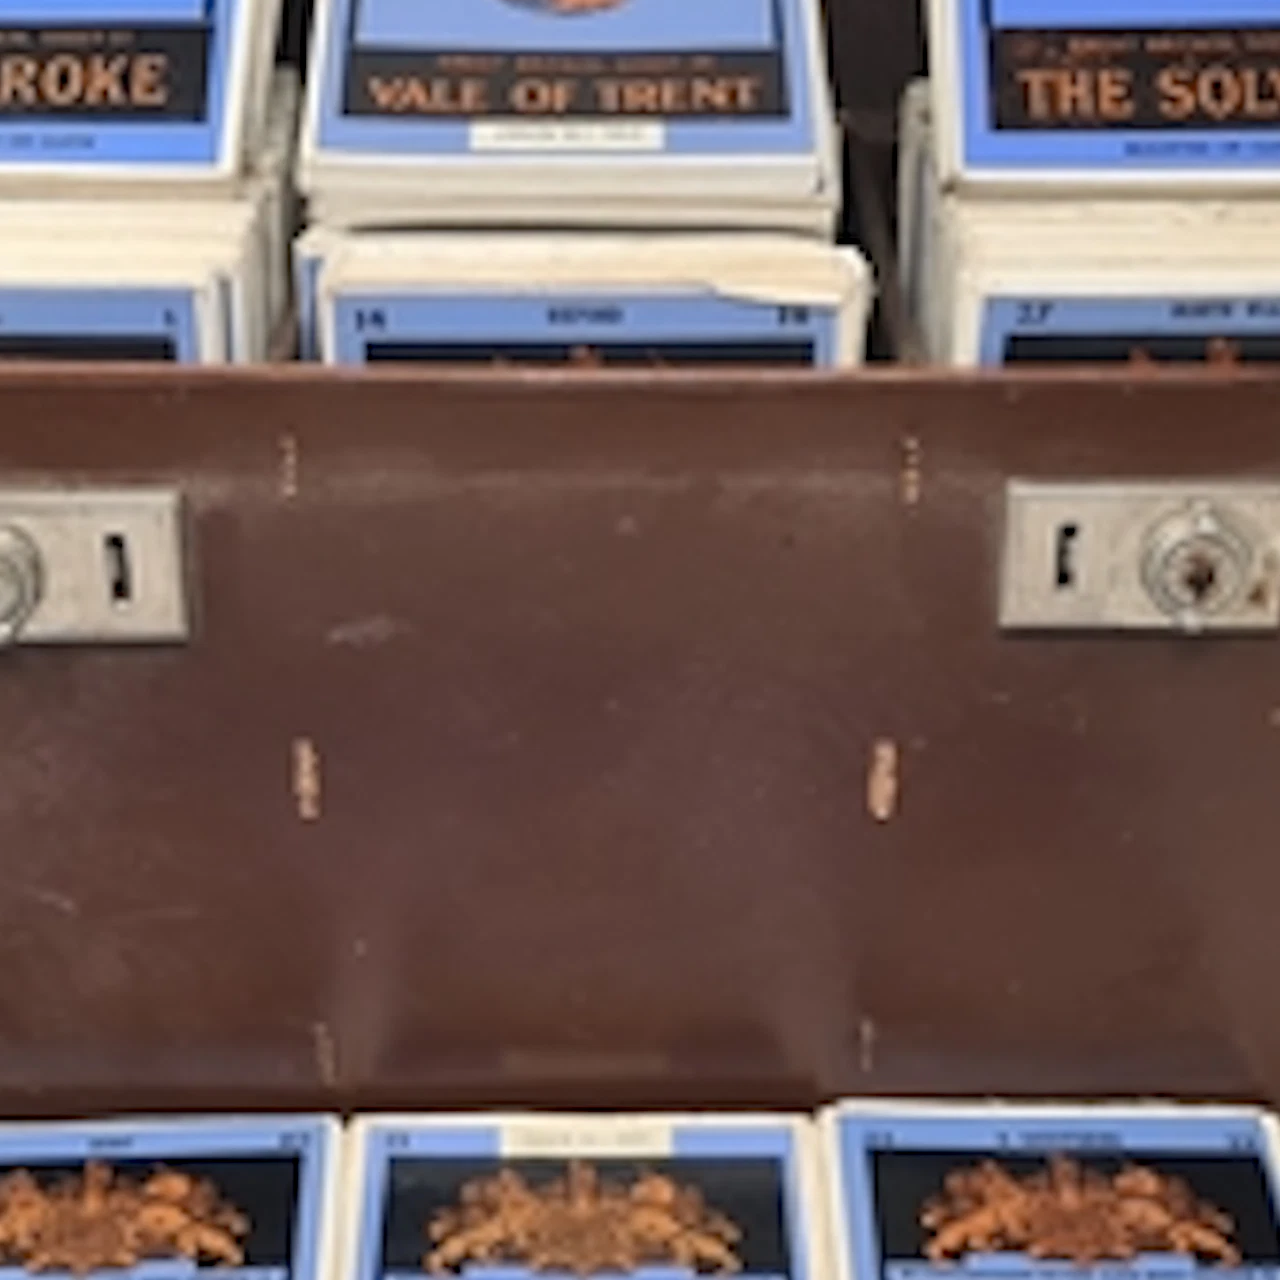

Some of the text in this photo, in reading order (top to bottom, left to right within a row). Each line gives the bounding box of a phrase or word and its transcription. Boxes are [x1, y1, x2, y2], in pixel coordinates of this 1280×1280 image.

[369, 75, 762, 111] VALE OF TRENT
[1017, 69, 1134, 118] THE
